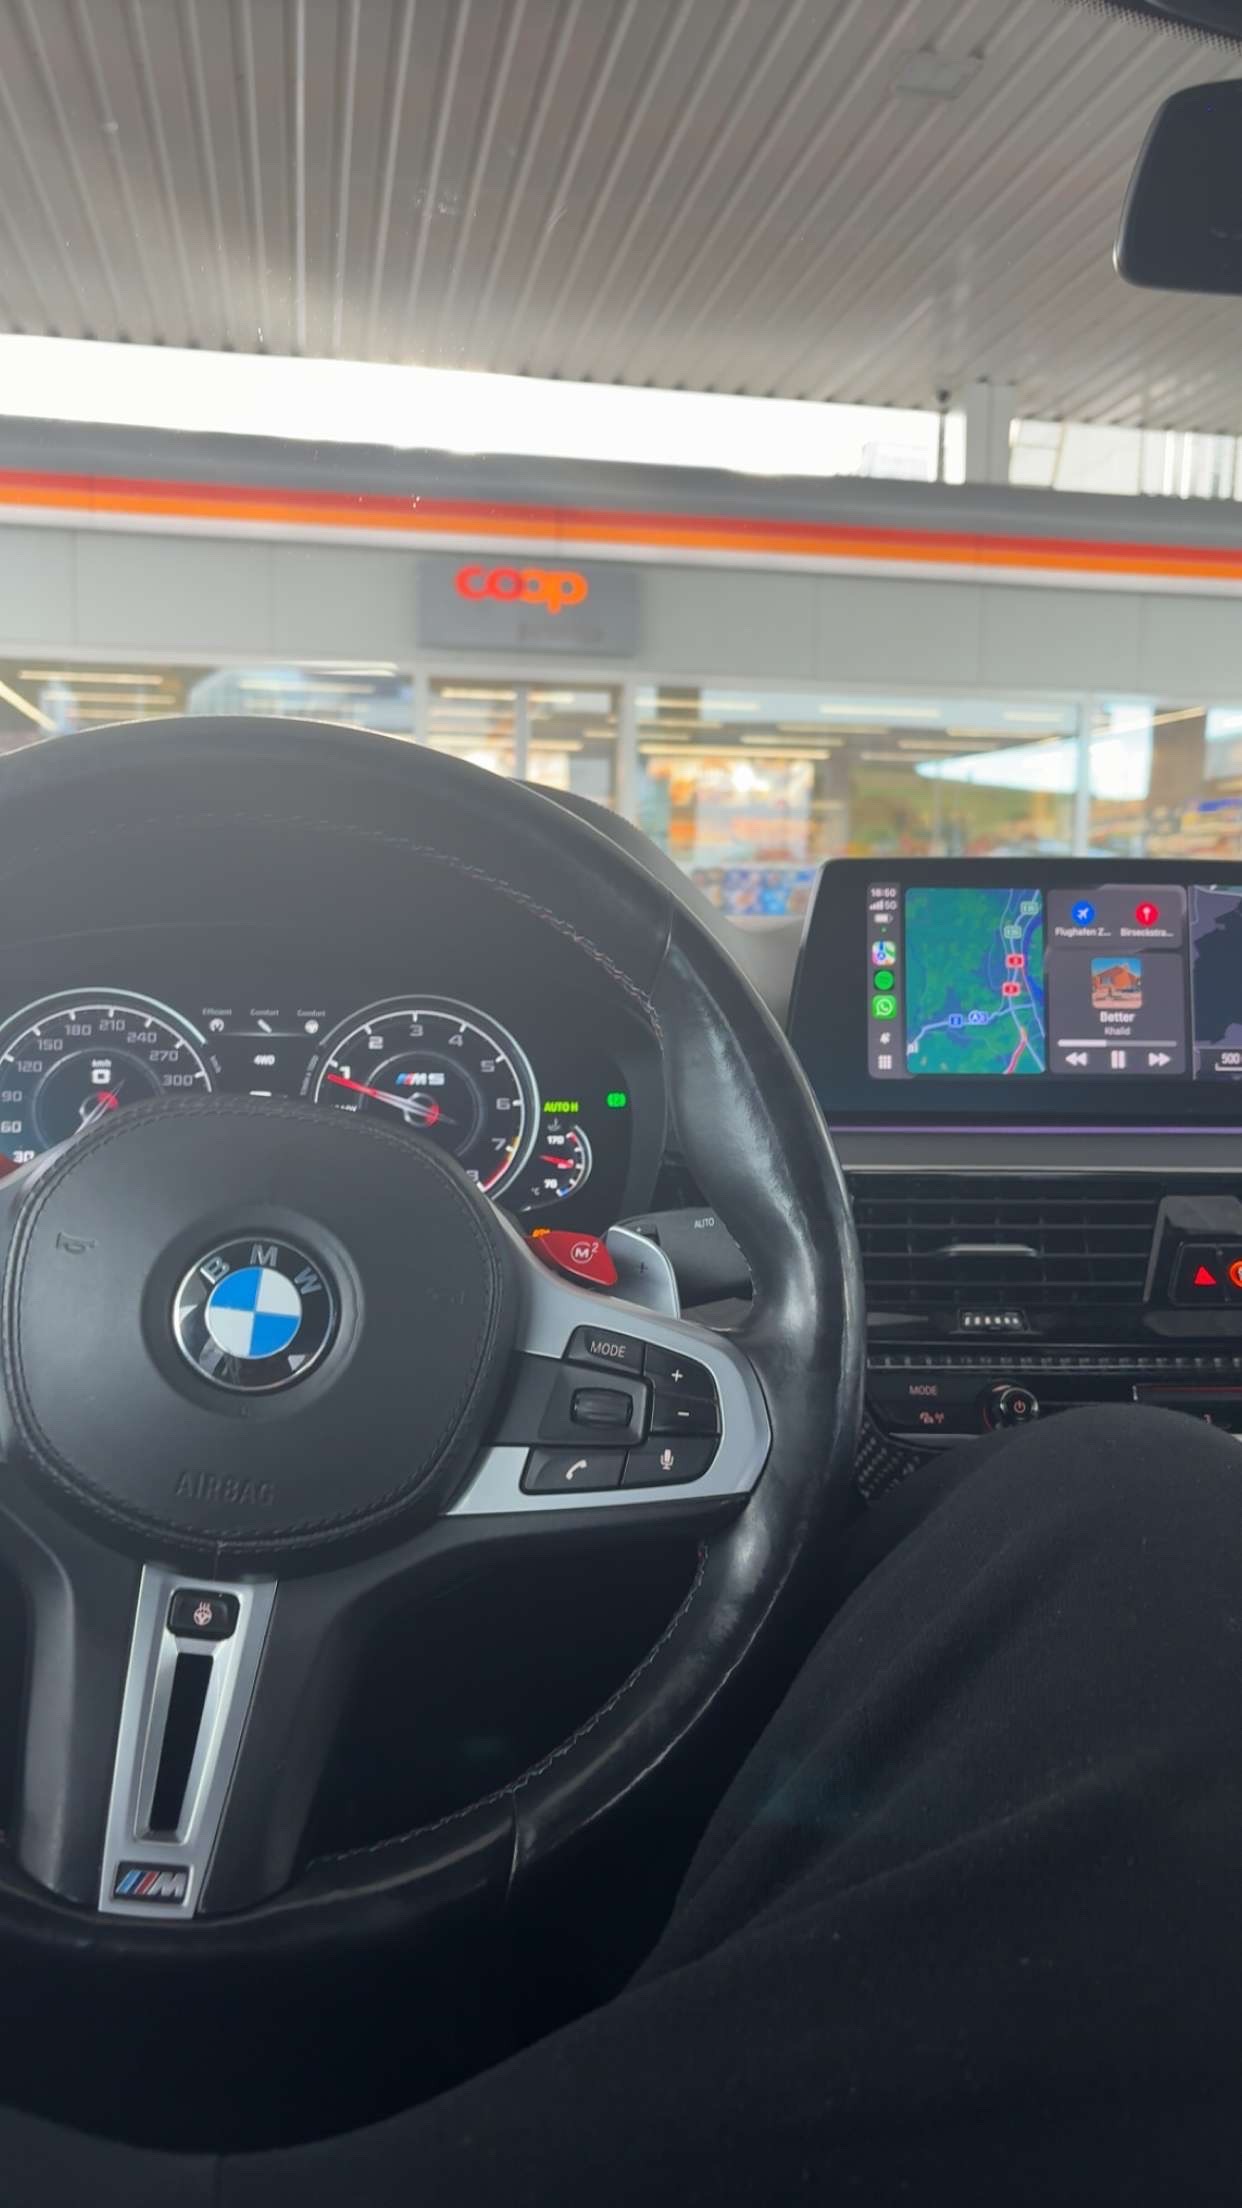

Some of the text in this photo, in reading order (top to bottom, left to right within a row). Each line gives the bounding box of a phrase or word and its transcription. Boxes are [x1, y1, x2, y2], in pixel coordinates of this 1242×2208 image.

[455, 566, 587, 614] coop
[1100, 1011, 1135, 1022] Better
[65, 1024, 92, 1036] 180
[100, 1019, 125, 1031] 210
[410, 1024, 423, 1036] 3
[1104, 1027, 1131, 1035] Khalid
[127, 1032, 157, 1043] 240
[368, 1036, 383, 1049] 2
[448, 1035, 463, 1046] 4
[37, 1039, 63, 1051] 150
[150, 1050, 179, 1062] 270
[254, 1055, 275, 1065] 4WD
[17, 1060, 42, 1072] 120
[481, 1060, 495, 1072] 5
[91, 1068, 111, 1085] 0
[163, 1074, 193, 1086] 300
[408, 1073, 444, 1085] M5
[2, 1091, 22, 1102] 90
[496, 1098, 510, 1109] 6
[544, 1102, 579, 1112] AUTO H
[1, 1121, 21, 1133] 60
[491, 1138, 506, 1151] 7
[547, 1135, 564, 1144] 170
[694, 1217, 715, 1228] AUTO
[200, 1245, 322, 1296] BMW
[590, 1341, 626, 1358] MODE
[909, 1385, 937, 1396] MODE
[176, 1471, 276, 1505] AIRBAG
